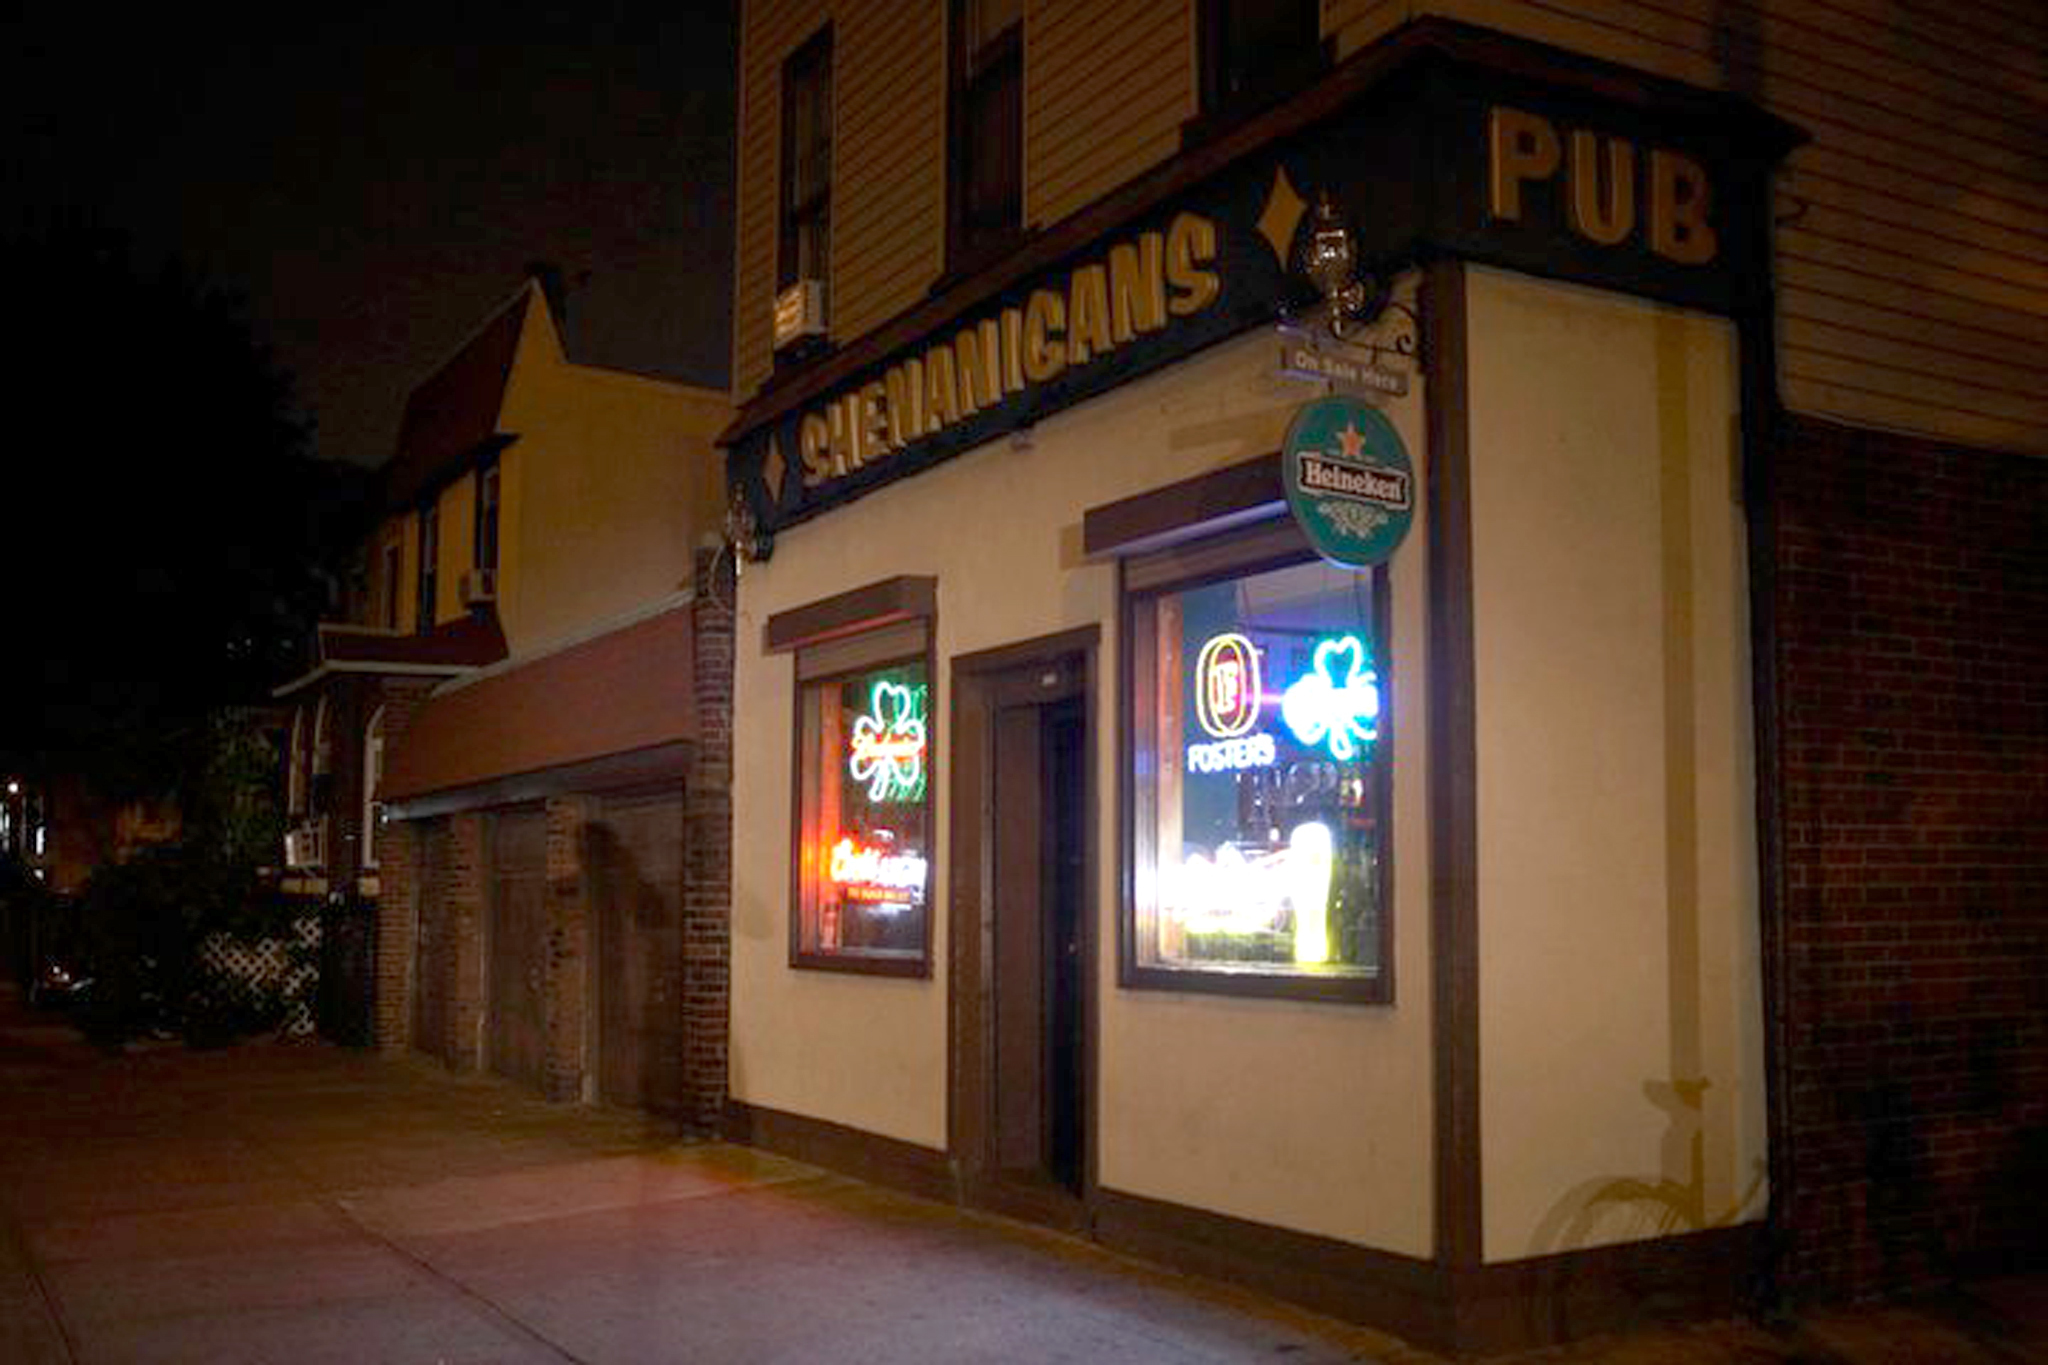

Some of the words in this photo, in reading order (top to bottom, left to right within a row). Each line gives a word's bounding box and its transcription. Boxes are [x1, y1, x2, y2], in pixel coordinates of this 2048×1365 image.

[1489, 103, 1718, 266] PUB
[800, 212, 1221, 487] SHENANIGANS
[1305, 459, 1402, 501] Heineken
